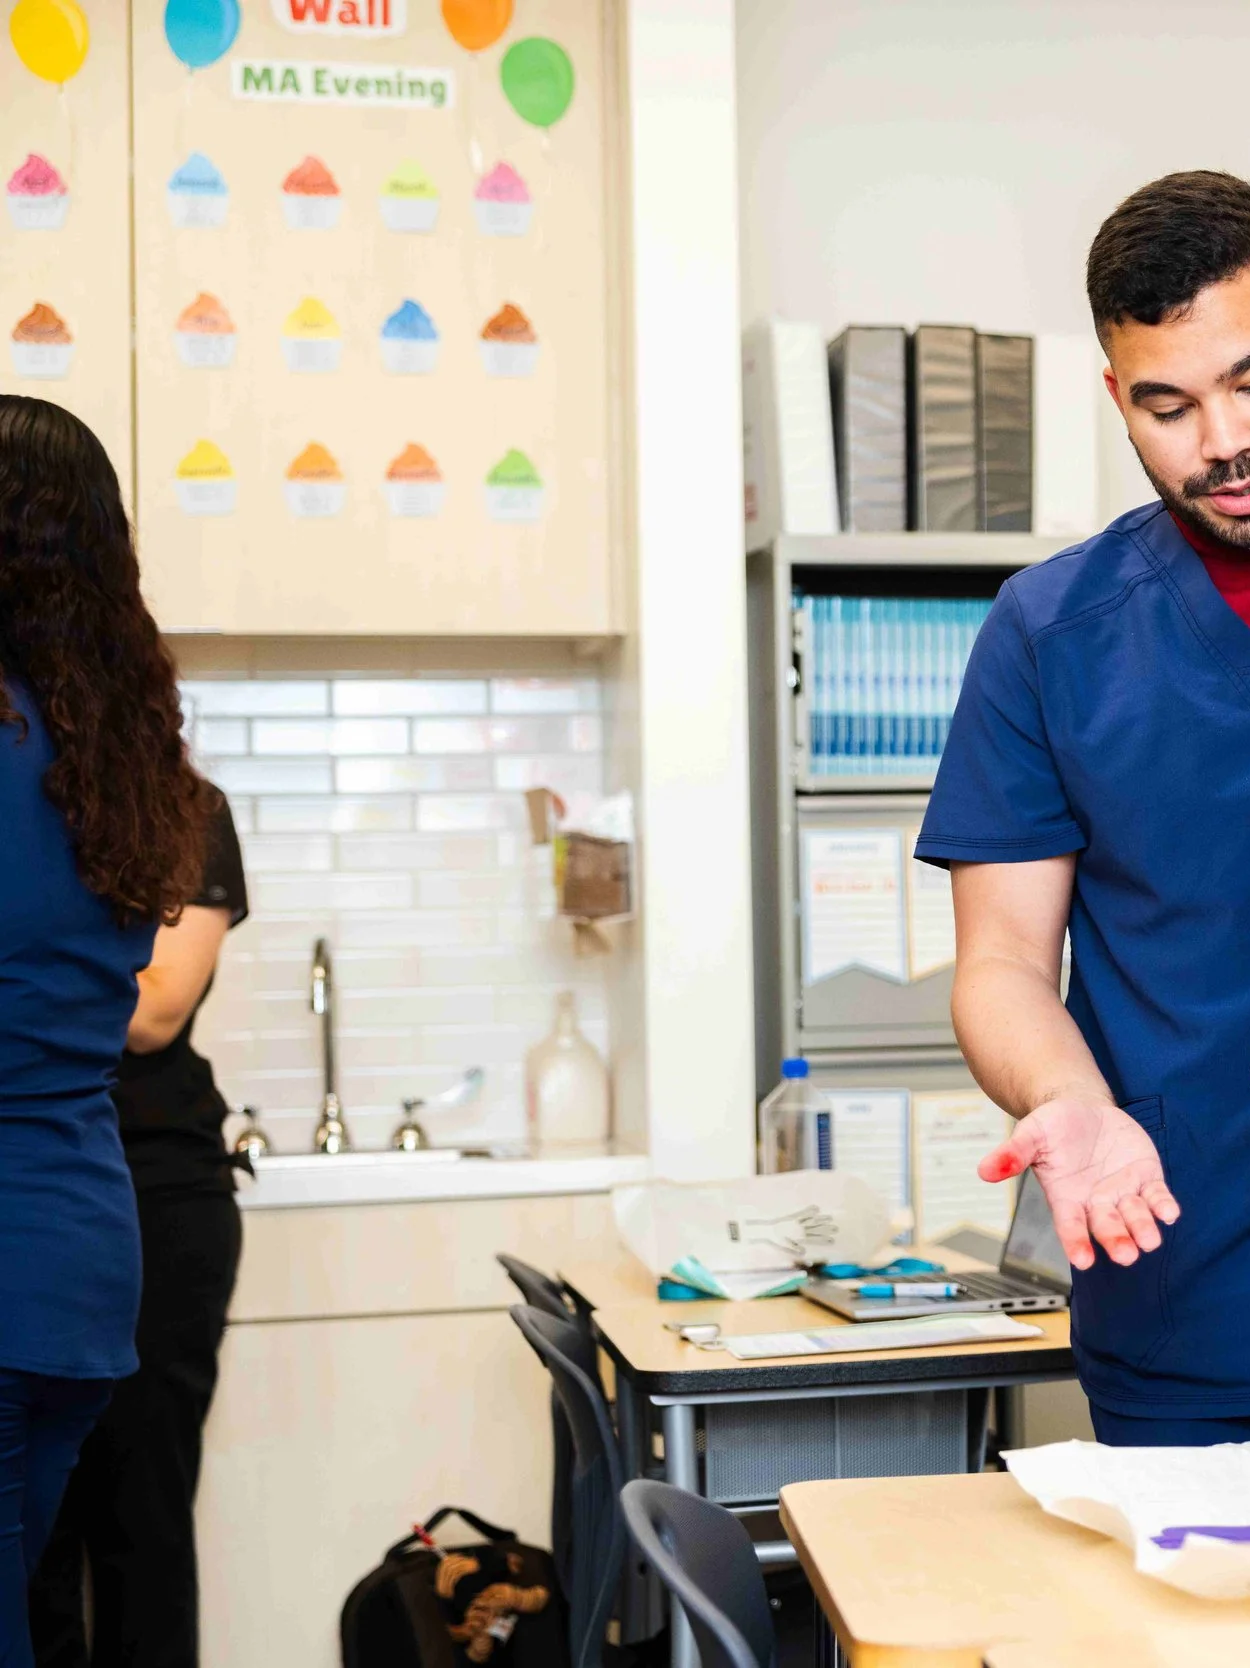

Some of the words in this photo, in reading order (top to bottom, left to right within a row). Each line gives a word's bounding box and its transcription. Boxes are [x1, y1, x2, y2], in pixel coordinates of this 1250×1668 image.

[288, 0, 391, 27] Wall
[242, 65, 302, 95] MA
[313, 69, 447, 107] Evening
